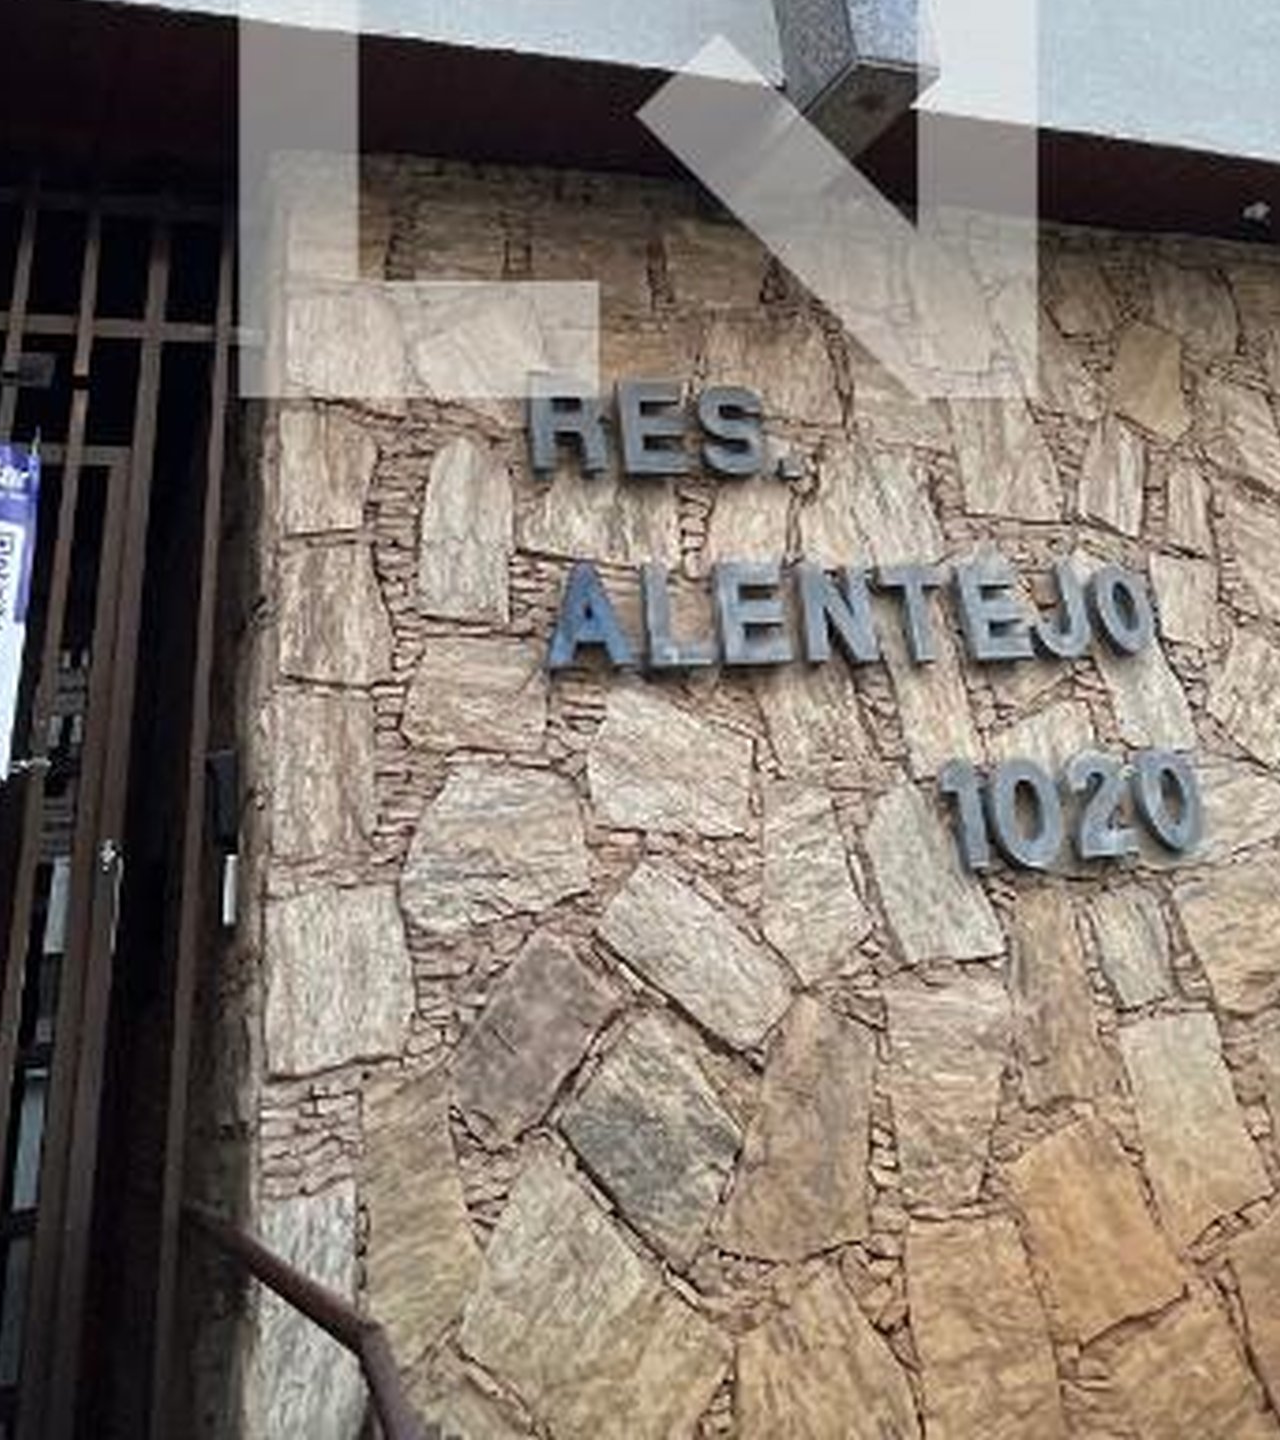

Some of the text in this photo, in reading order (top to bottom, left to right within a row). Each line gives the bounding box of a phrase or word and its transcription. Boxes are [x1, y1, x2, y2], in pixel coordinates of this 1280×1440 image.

[525, 381, 804, 478] RES.
[546, 552, 1158, 668] ALENTEJO
[940, 750, 1204, 870] 1020
